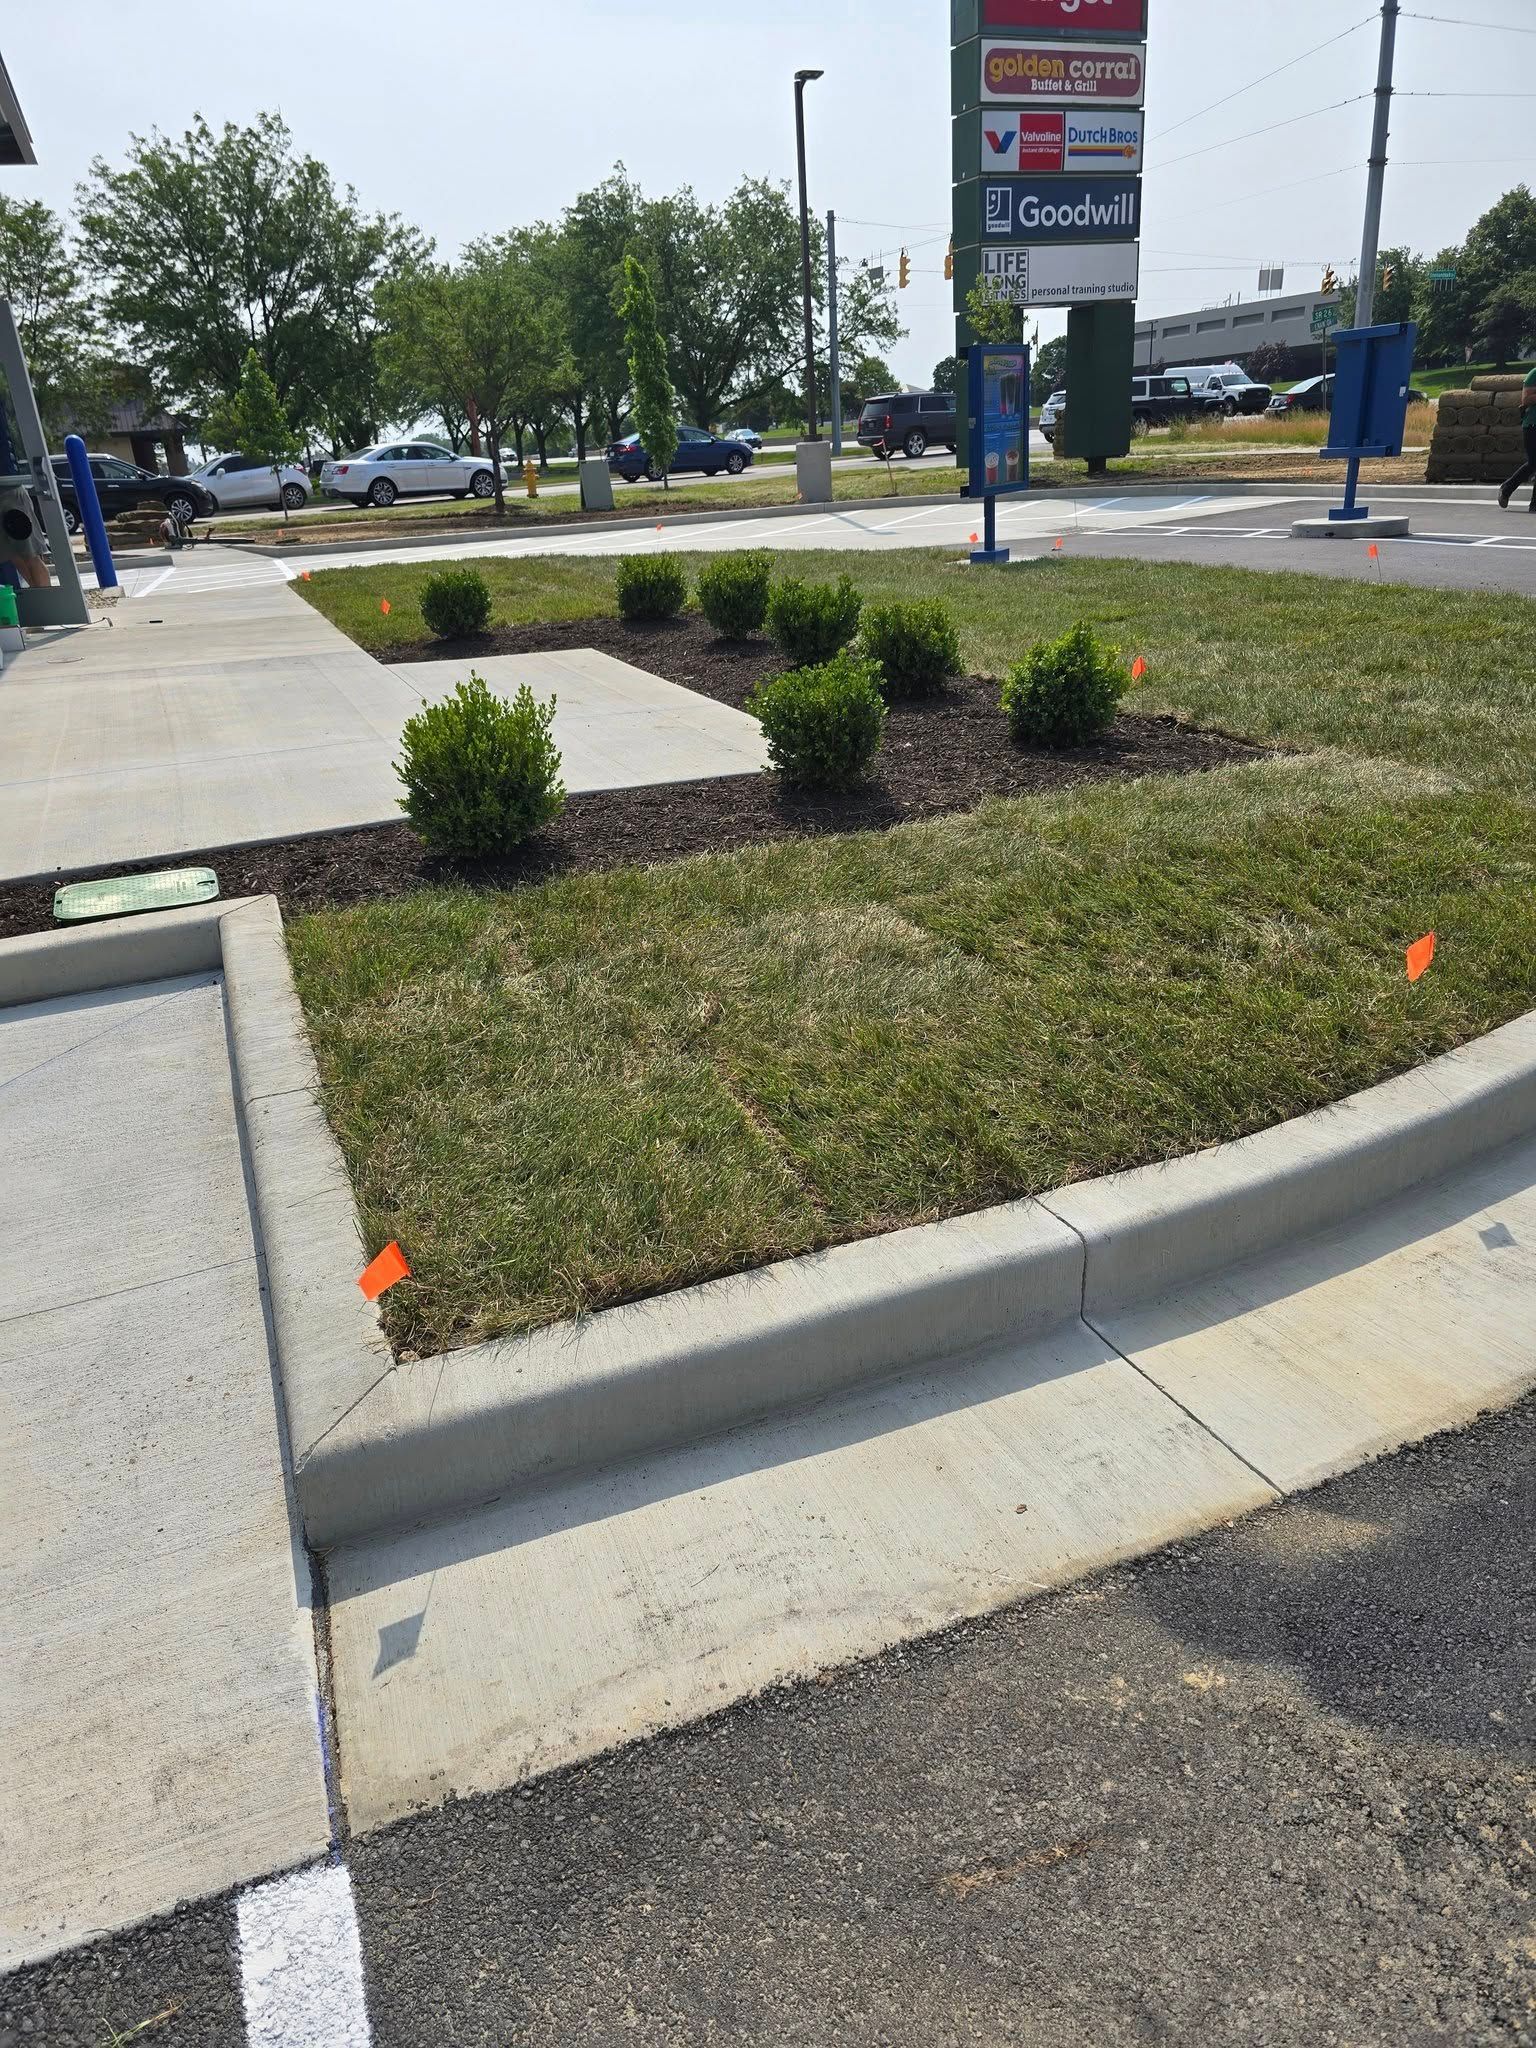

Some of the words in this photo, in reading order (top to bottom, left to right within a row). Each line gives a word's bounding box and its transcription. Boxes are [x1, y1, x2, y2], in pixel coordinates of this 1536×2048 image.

[989, 54, 1064, 83] golden
[1069, 58, 1137, 79] corral
[1031, 79, 1062, 91] Buffet
[1064, 80, 1072, 91] &
[1074, 80, 1097, 92] Grill
[1021, 131, 1061, 142] Valvoline
[1019, 193, 1134, 228] Goodwill
[988, 223, 1010, 231] goodwill
[984, 252, 1027, 274] LIFE
[1031, 285, 1070, 297] personal
[1071, 282, 1106, 295] training
[1108, 282, 1135, 292] studio
